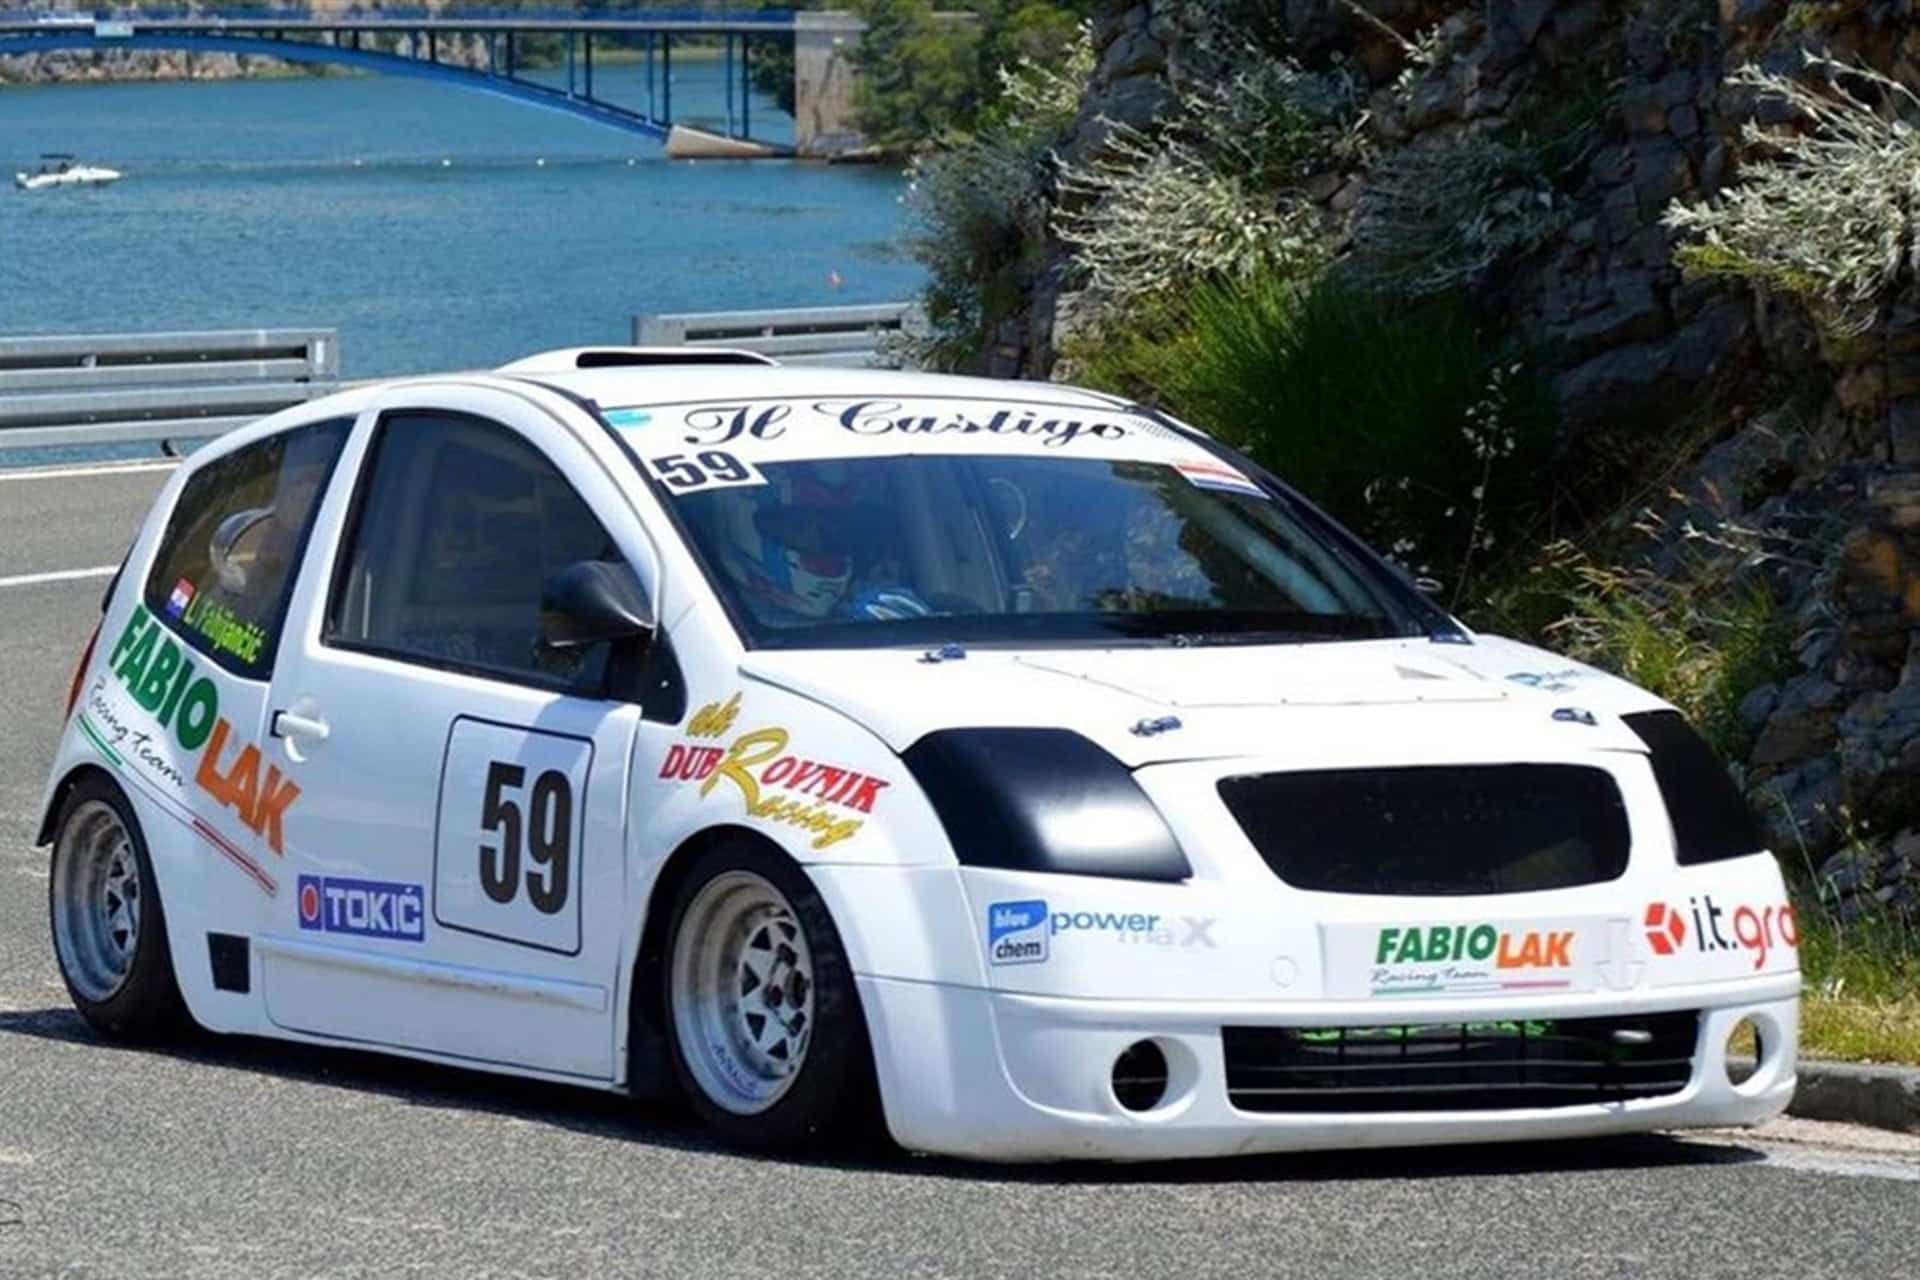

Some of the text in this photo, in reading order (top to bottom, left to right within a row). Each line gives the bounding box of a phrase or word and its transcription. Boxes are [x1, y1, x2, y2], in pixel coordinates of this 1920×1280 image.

[684, 400, 1125, 448] Il Castigo
[651, 450, 750, 487] 59
[479, 761, 573, 915] 59
[325, 886, 421, 935] TOKIĆ
[1050, 911, 1160, 936] power
[995, 938, 1041, 959] chem
